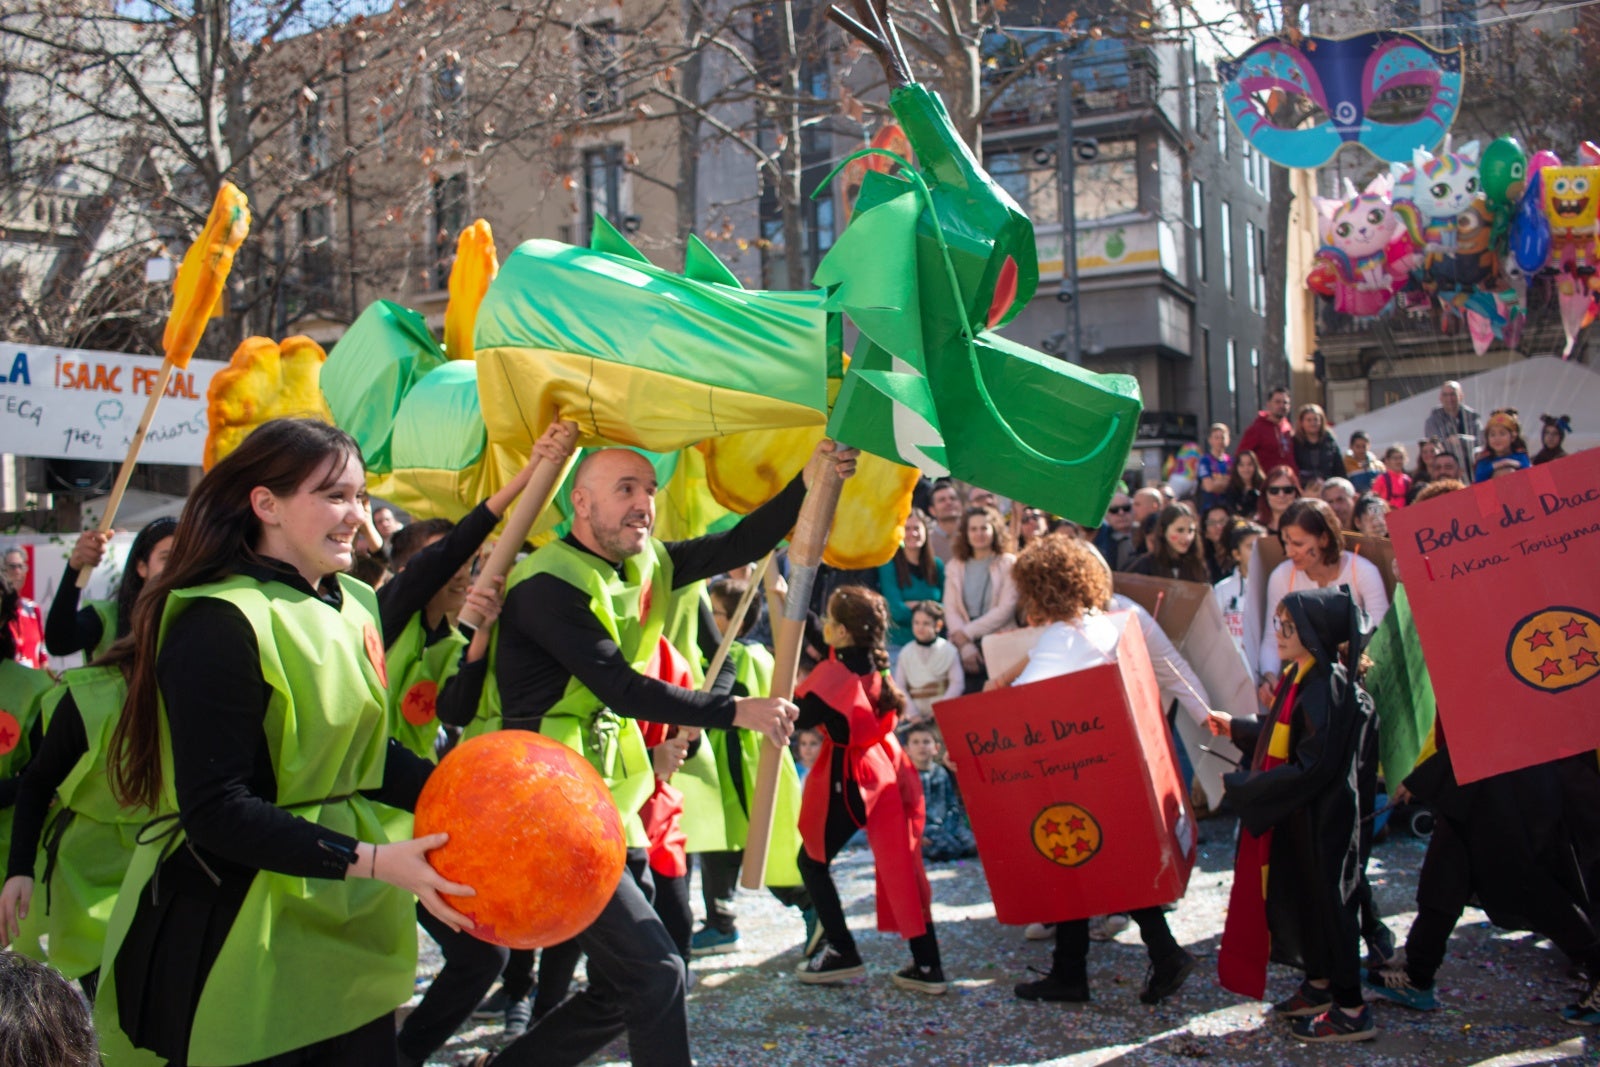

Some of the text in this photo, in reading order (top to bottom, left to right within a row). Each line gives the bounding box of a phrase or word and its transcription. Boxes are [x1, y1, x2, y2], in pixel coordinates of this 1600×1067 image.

[1415, 488, 1600, 554] Bola de Drac
[1511, 522, 1600, 556] Toriyama
[965, 716, 1105, 756] Bola de Drac
